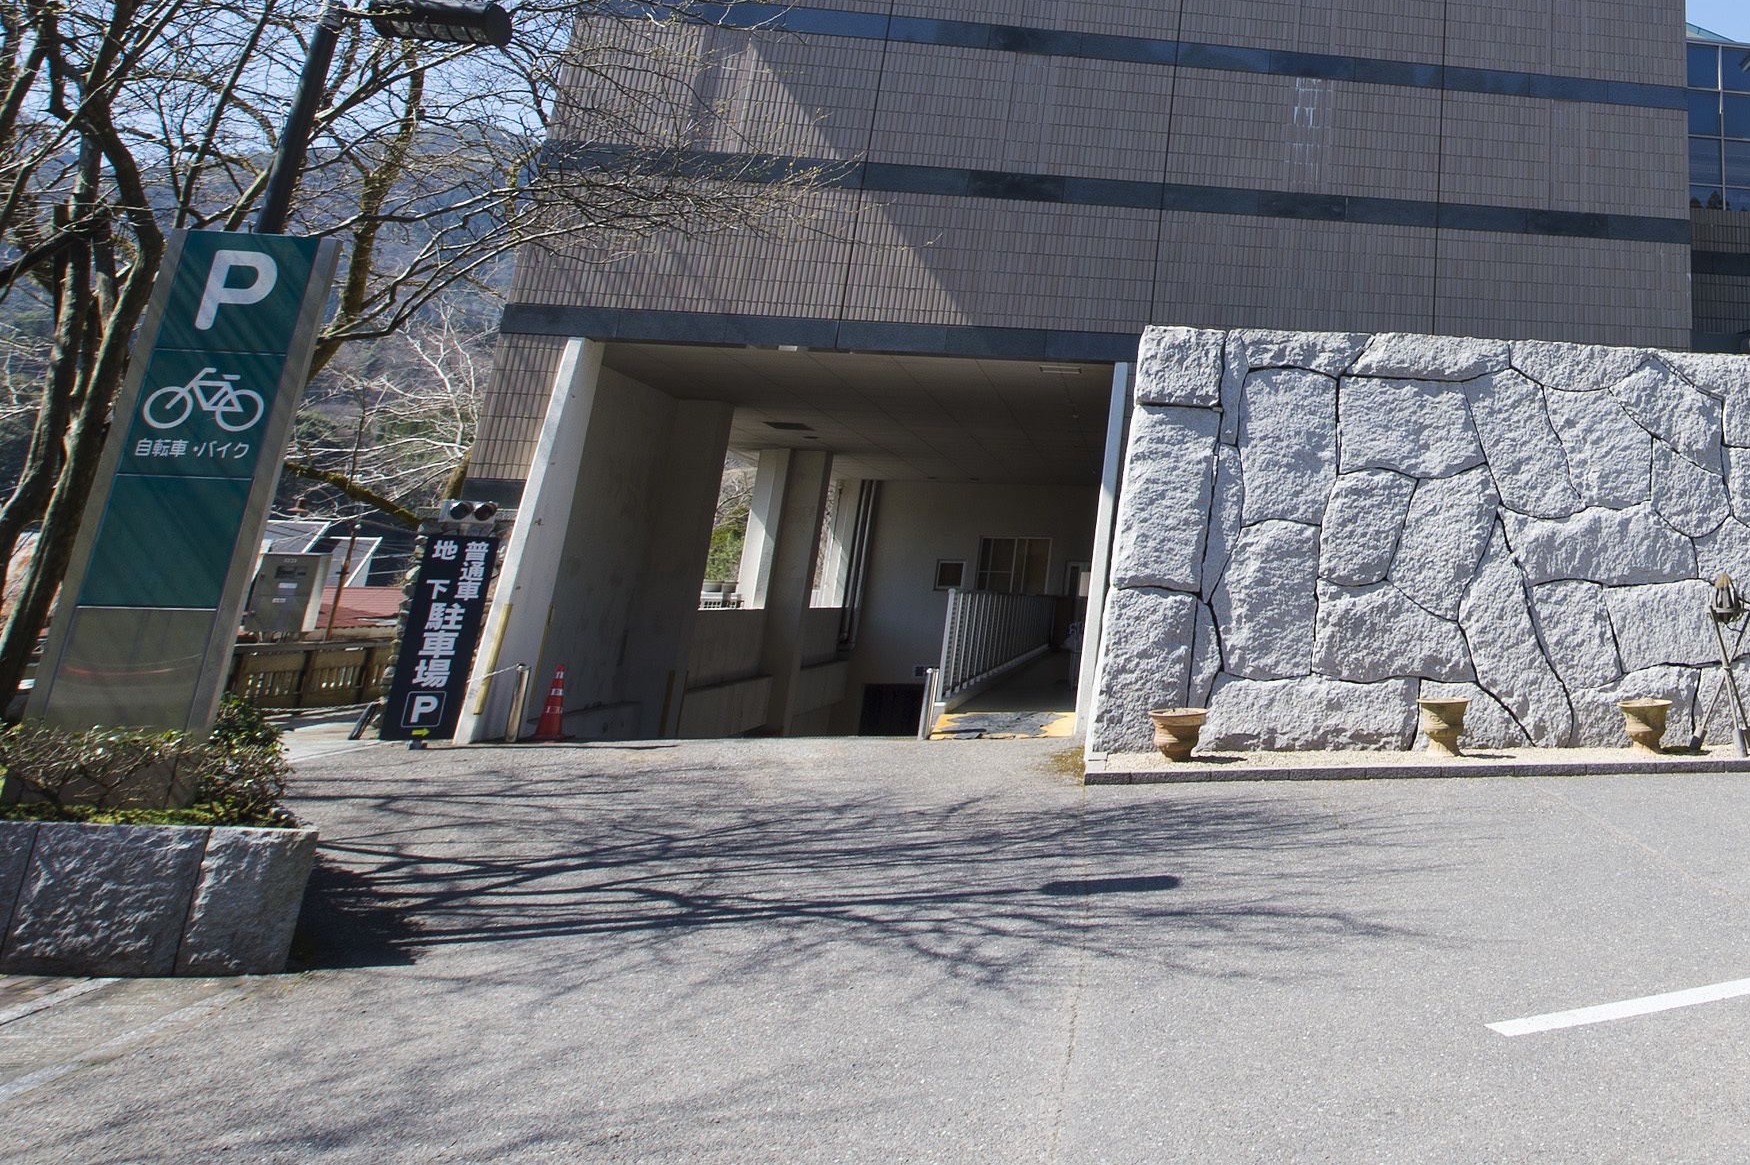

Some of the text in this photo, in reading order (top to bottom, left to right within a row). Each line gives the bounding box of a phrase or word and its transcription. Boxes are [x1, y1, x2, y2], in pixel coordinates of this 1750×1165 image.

[195, 249, 278, 330] P
[135, 438, 250, 459] 自転車・バイク
[453, 541, 490, 602] 普通車
[409, 695, 439, 724] P
